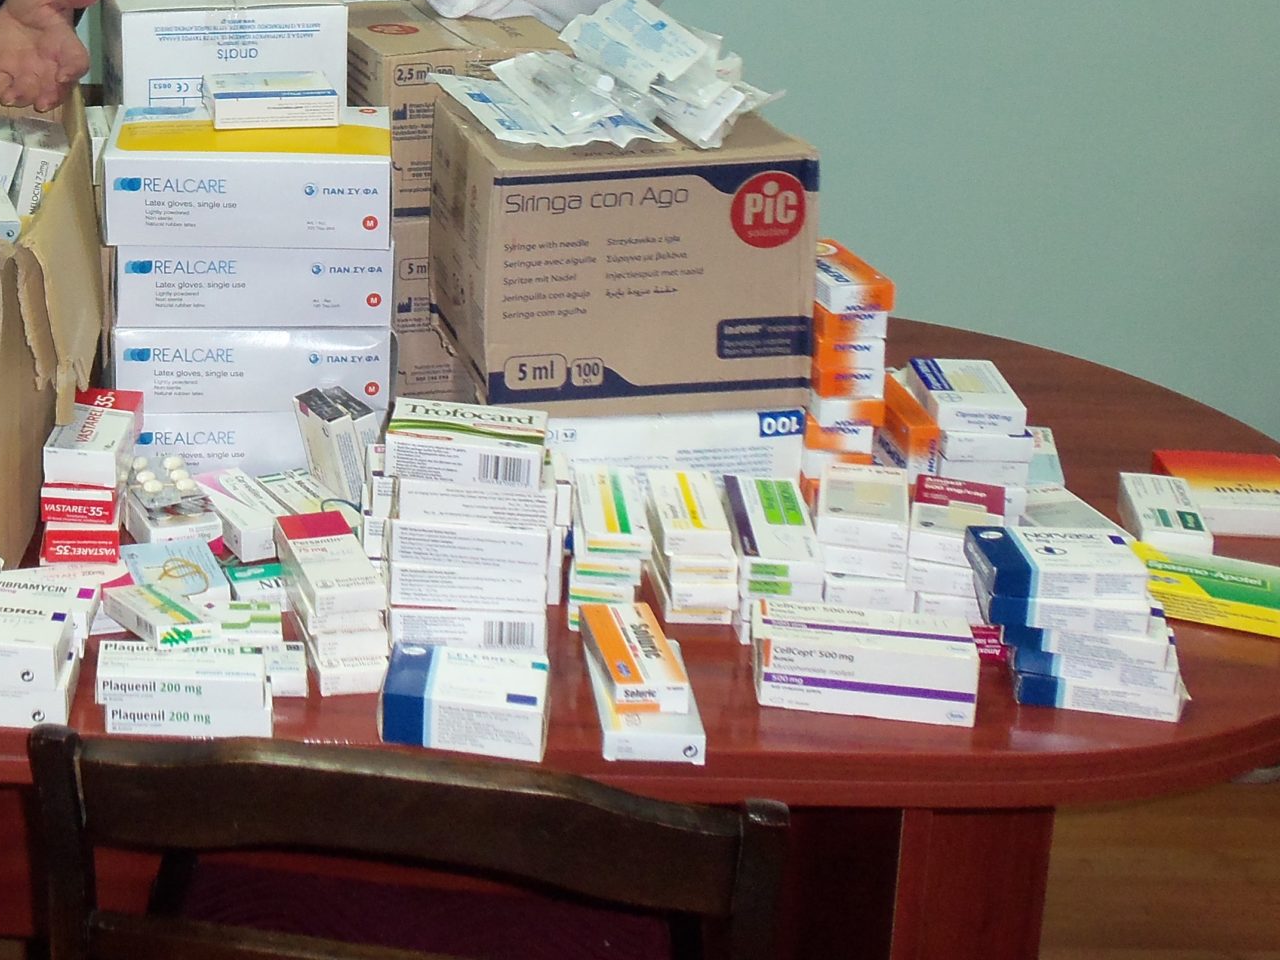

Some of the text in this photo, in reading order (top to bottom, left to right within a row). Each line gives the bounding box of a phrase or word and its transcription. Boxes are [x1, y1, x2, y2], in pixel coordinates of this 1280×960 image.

[217, 48, 258, 62] anats
[396, 68, 414, 82] 2,5
[143, 178, 227, 194] REALCARE
[145, 199, 166, 207] Latex
[197, 200, 221, 210] single
[505, 187, 690, 215] Siringa con Ago
[742, 181, 800, 227] PiC
[504, 239, 590, 253] Syringe with needle
[154, 260, 237, 274] REALCARE
[407, 263, 415, 275] 5
[504, 259, 542, 269] Seringue
[207, 280, 230, 290] single
[535, 275, 550, 283] mit
[551, 274, 577, 283] Nadel
[548, 292, 565, 300] con
[502, 310, 535, 320] Seringa
[536, 309, 556, 318] com
[834, 344, 872, 352] DEPON
[152, 348, 235, 363] REALCARE
[153, 369, 174, 377] Latex
[205, 370, 229, 379] single
[517, 360, 556, 382] 5 ml
[575, 361, 601, 379] 100
[834, 373, 872, 381] DEPON
[405, 402, 536, 426] Trofocard
[75, 407, 105, 444] VASTAREL
[761, 416, 801, 435] 100
[154, 432, 236, 445] REALCARE
[207, 451, 230, 460] single
[44, 503, 104, 517] VASTAREL 35
[55, 545, 116, 556] 35 VASTAREL
[773, 645, 855, 663] CellCept 500 mg
[102, 680, 203, 696] Plaquenil 200 mg
[111, 709, 211, 725] Plaquenil 200 mg
